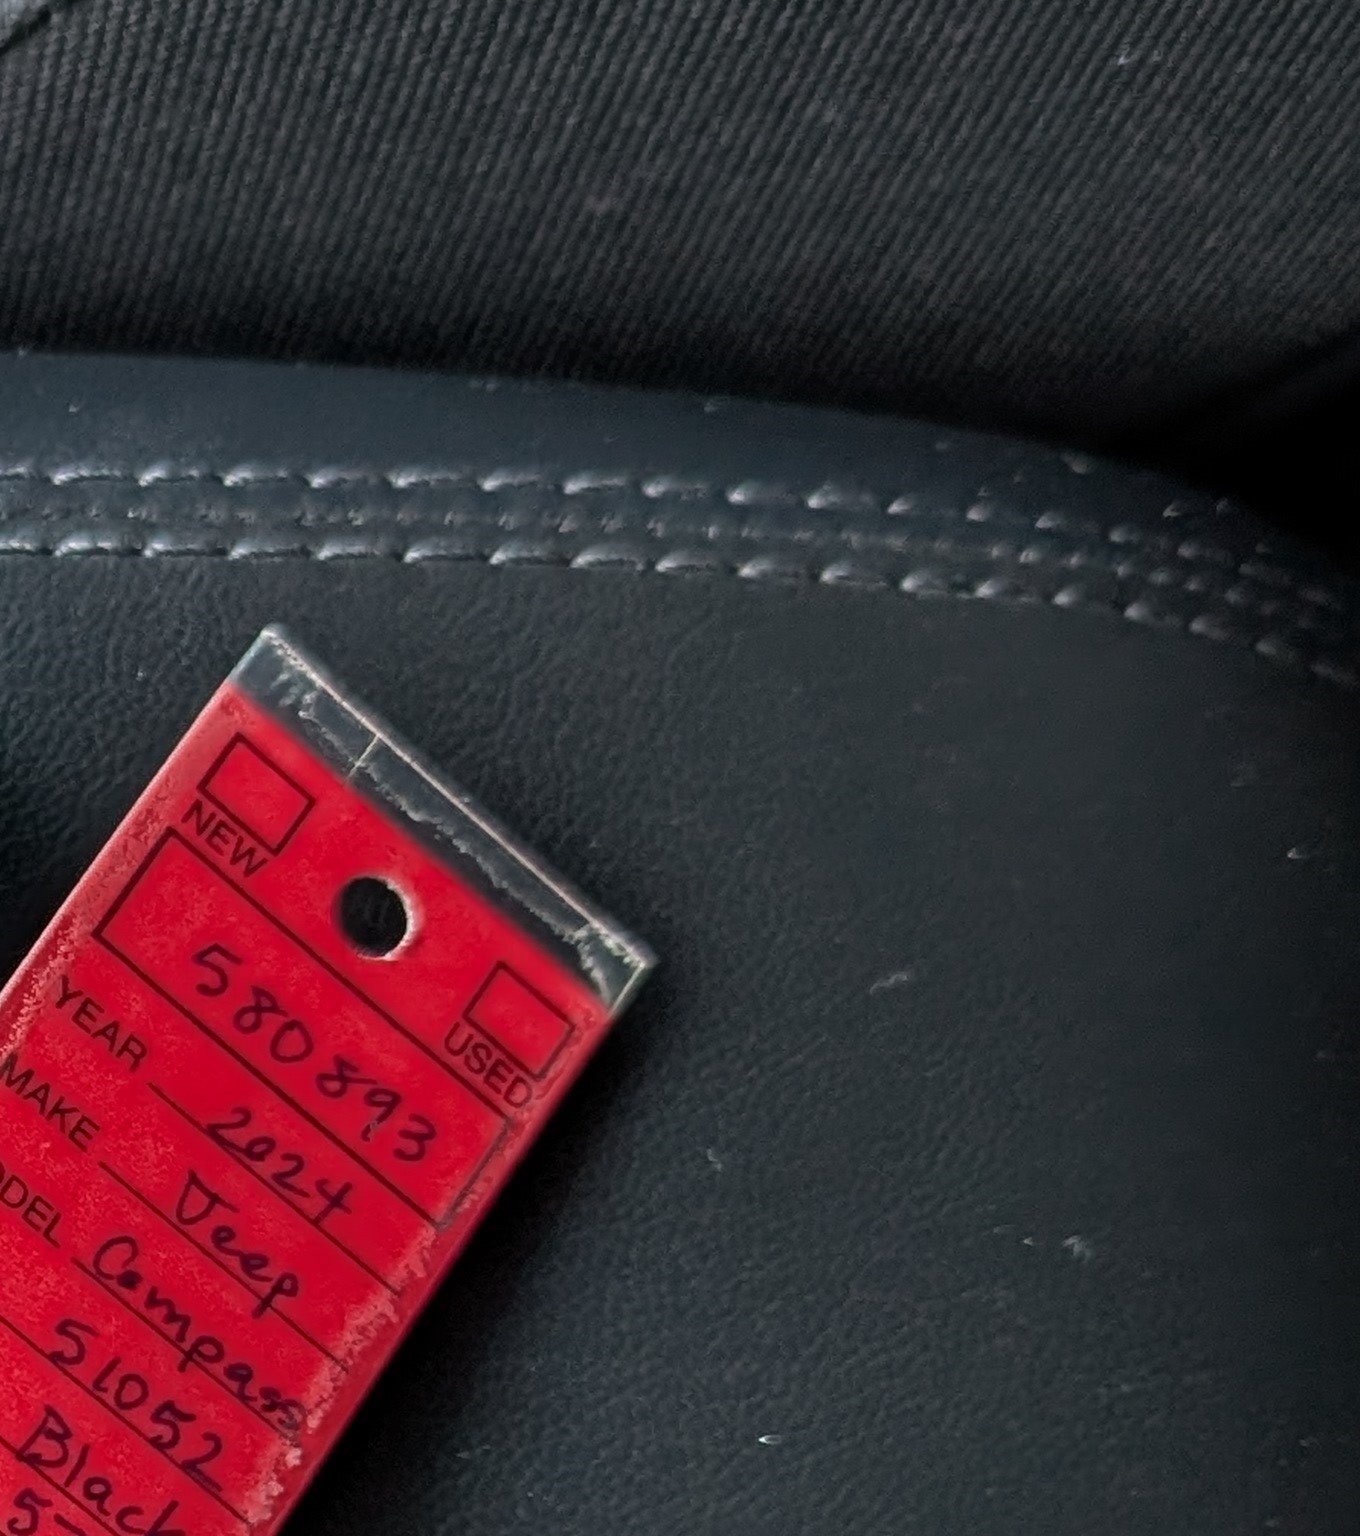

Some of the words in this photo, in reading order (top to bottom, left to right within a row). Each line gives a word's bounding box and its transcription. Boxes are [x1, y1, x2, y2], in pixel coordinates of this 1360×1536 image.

[181, 799, 268, 879] NEW
[52, 975, 148, 1073] YEAR
[193, 944, 436, 1163] 580893
[442, 1021, 534, 1109] USED
[206, 1106, 353, 1225] 2024
[173, 1169, 300, 1319] Jeep
[49, 1318, 224, 1493] 51052
